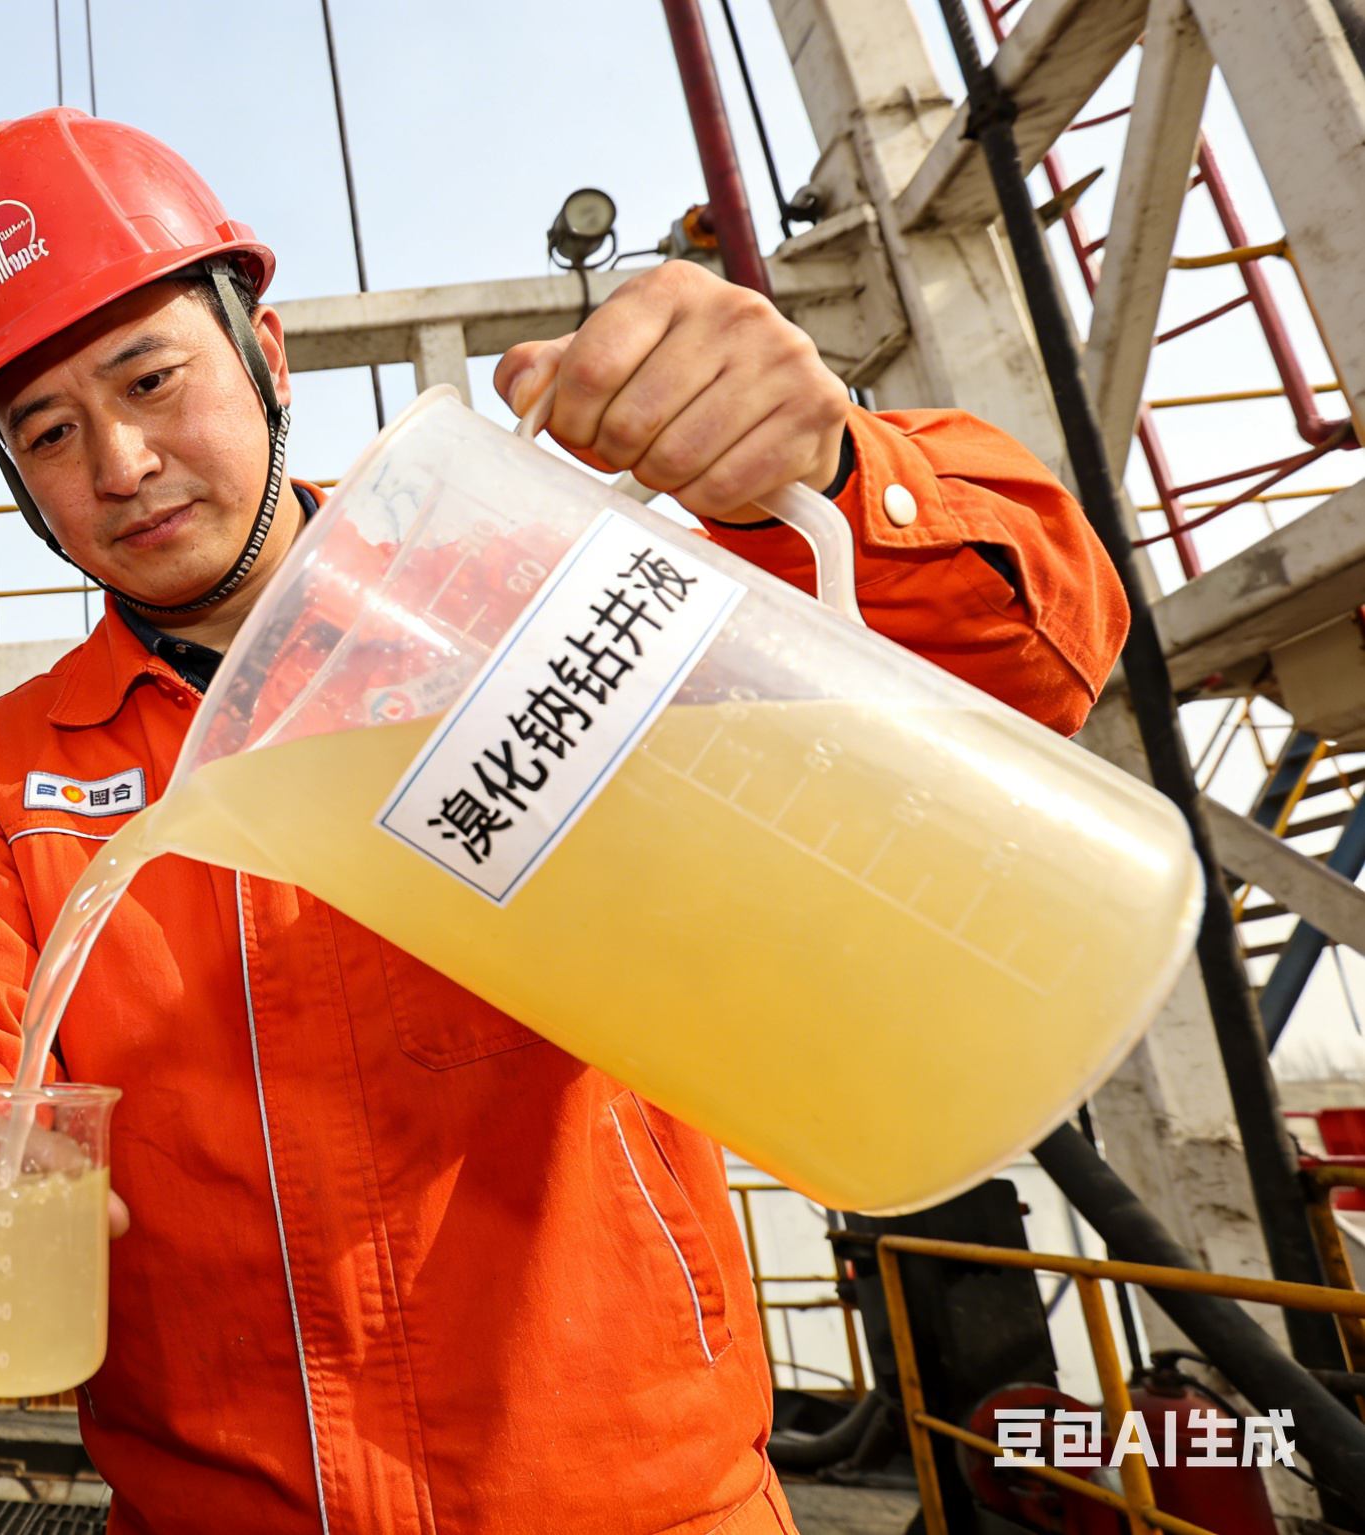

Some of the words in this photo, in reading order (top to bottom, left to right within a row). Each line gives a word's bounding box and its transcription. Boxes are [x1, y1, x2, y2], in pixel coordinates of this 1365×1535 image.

[427, 548, 698, 864] 溴化钠钻井液
